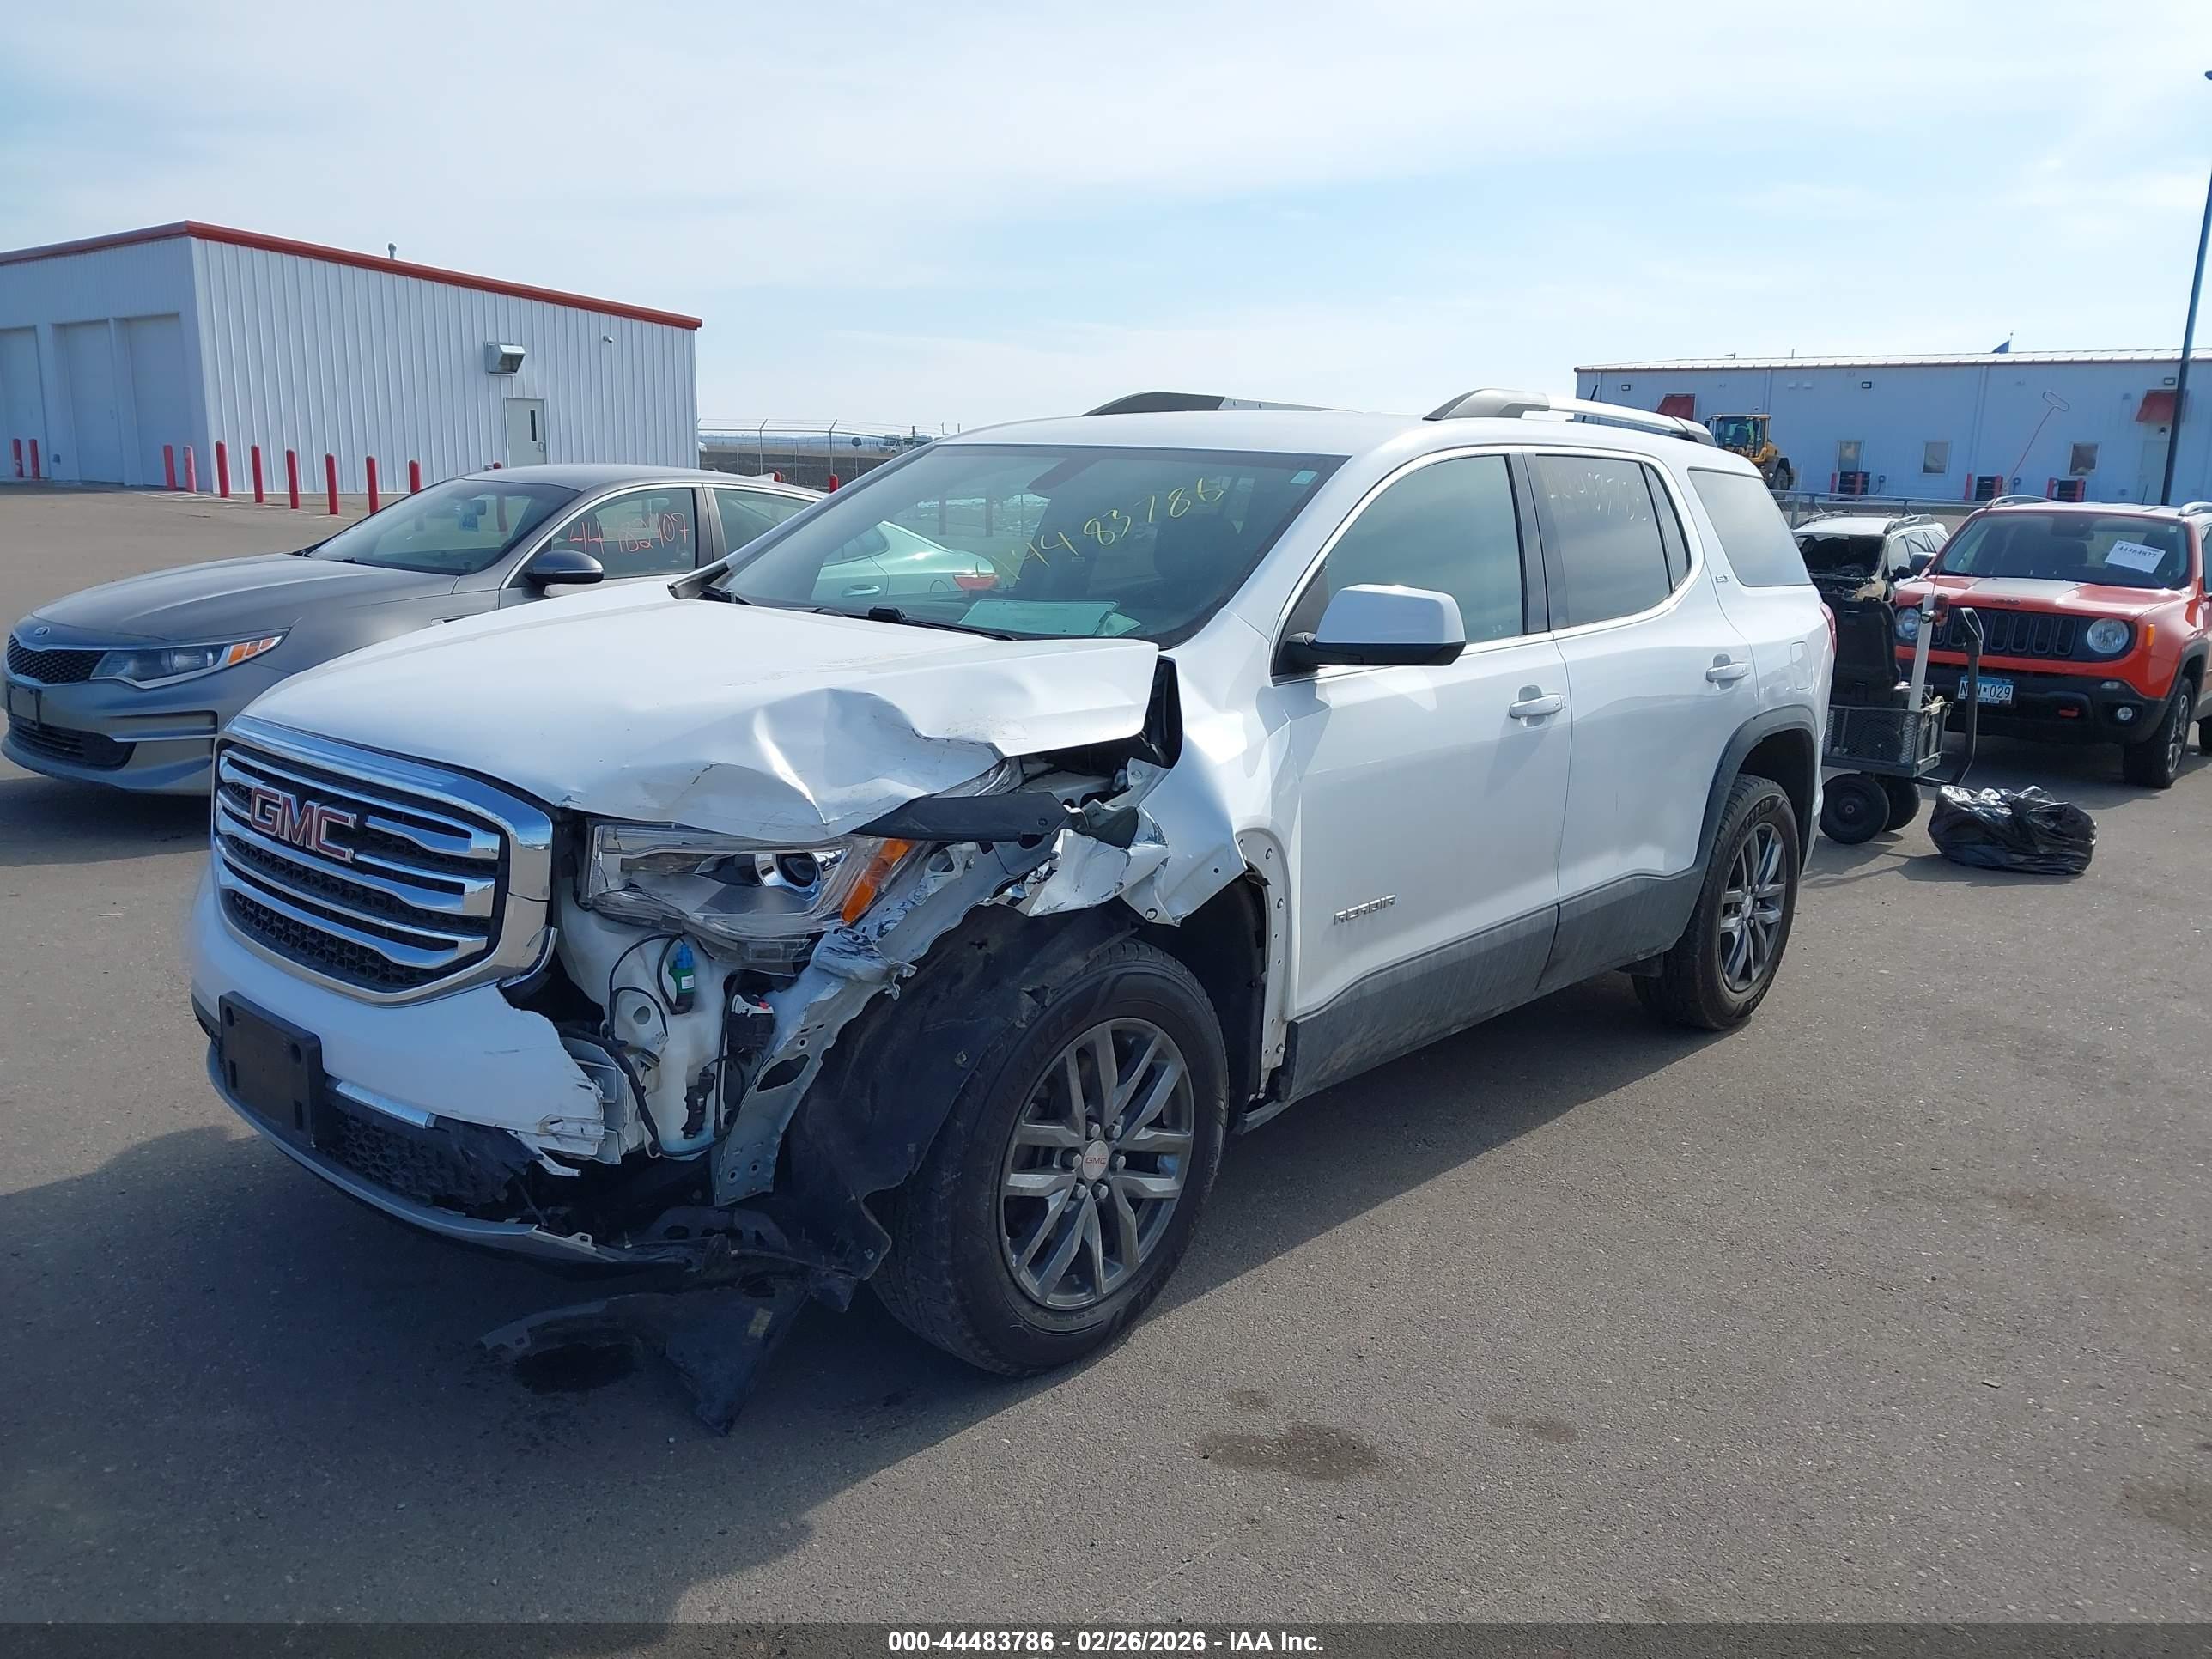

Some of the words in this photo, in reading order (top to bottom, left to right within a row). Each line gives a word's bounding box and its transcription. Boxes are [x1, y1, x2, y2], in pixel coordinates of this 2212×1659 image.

[1960, 681, 1983, 696] NN
[1990, 685, 2011, 698] 029
[250, 787, 357, 863] GMC
[1333, 894, 1396, 926] ACADIA
